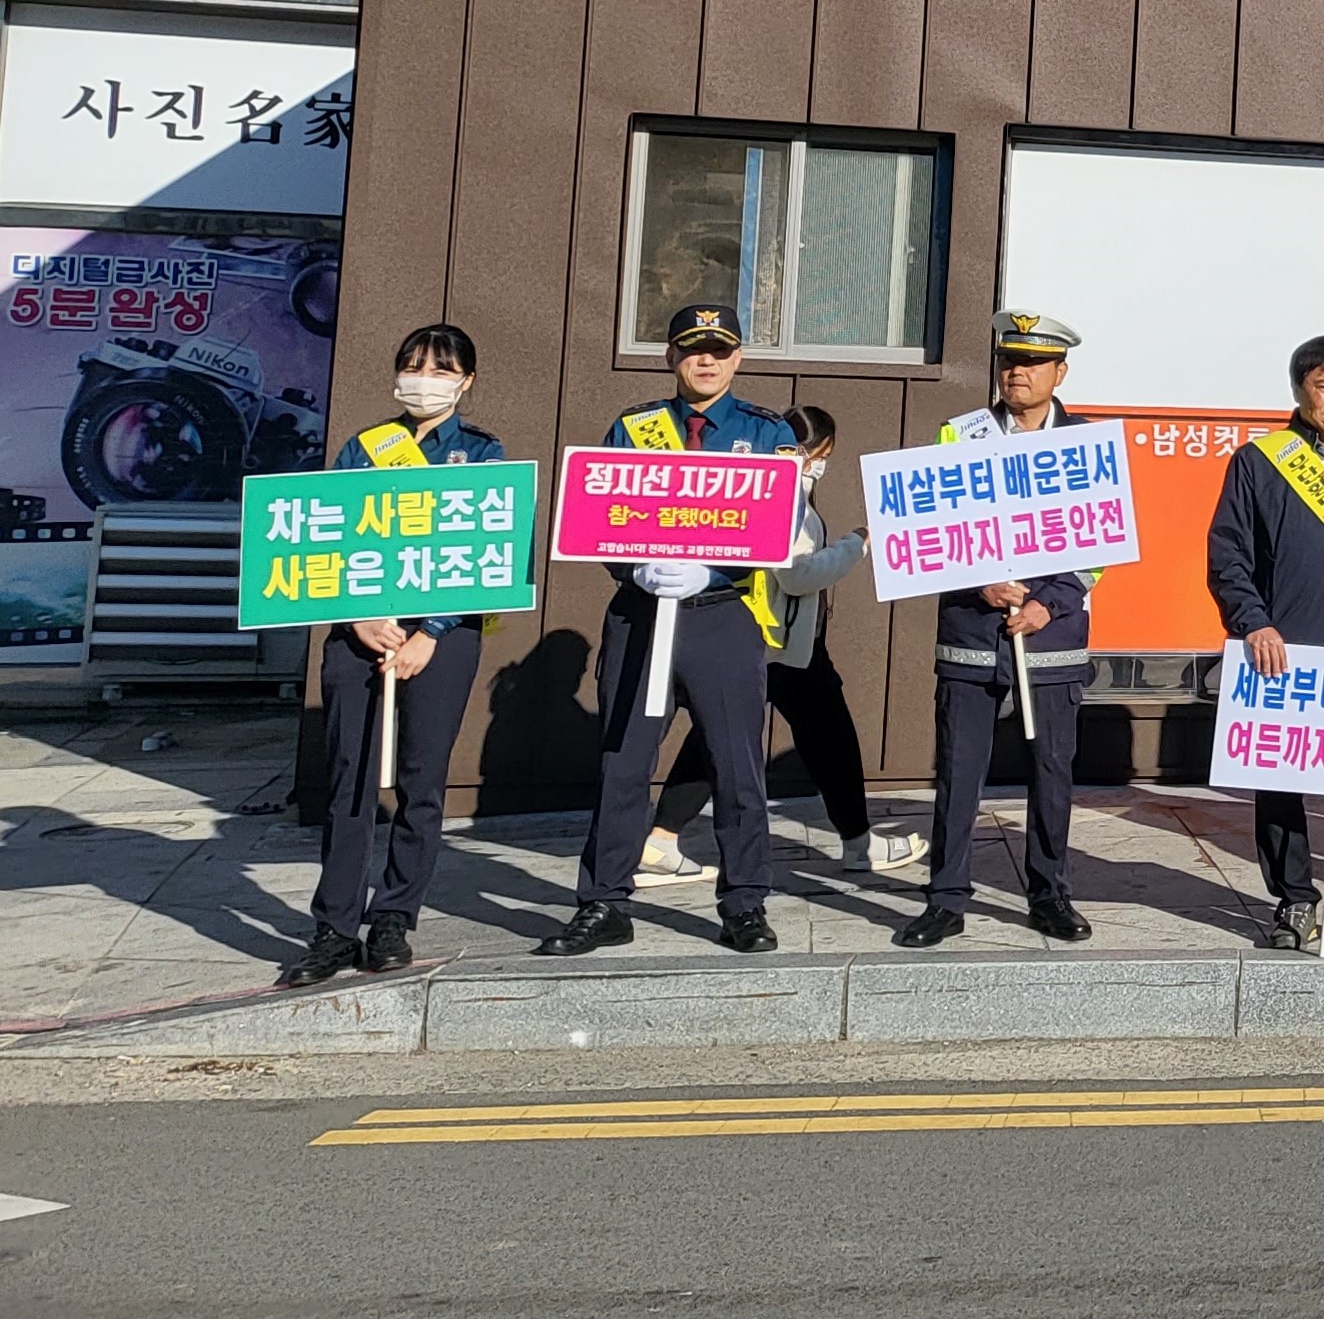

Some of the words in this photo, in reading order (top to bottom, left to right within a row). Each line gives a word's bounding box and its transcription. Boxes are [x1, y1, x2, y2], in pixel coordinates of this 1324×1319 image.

[9, 287, 214, 334] 5분완성
[585, 462, 671, 497] 정지선
[676, 465, 778, 500] 지키기!
[879, 458, 996, 517] 세살부터
[1002, 441, 1119, 499] 배운질서
[266, 497, 345, 543] 차는
[356, 487, 515, 537] 사람조심
[657, 507, 748, 530] 잘했어요!
[885, 516, 1004, 576] 여든까지
[1010, 498, 1127, 557] 교통안전
[262, 551, 384, 601] 사람은
[396, 542, 514, 592] 차조심
